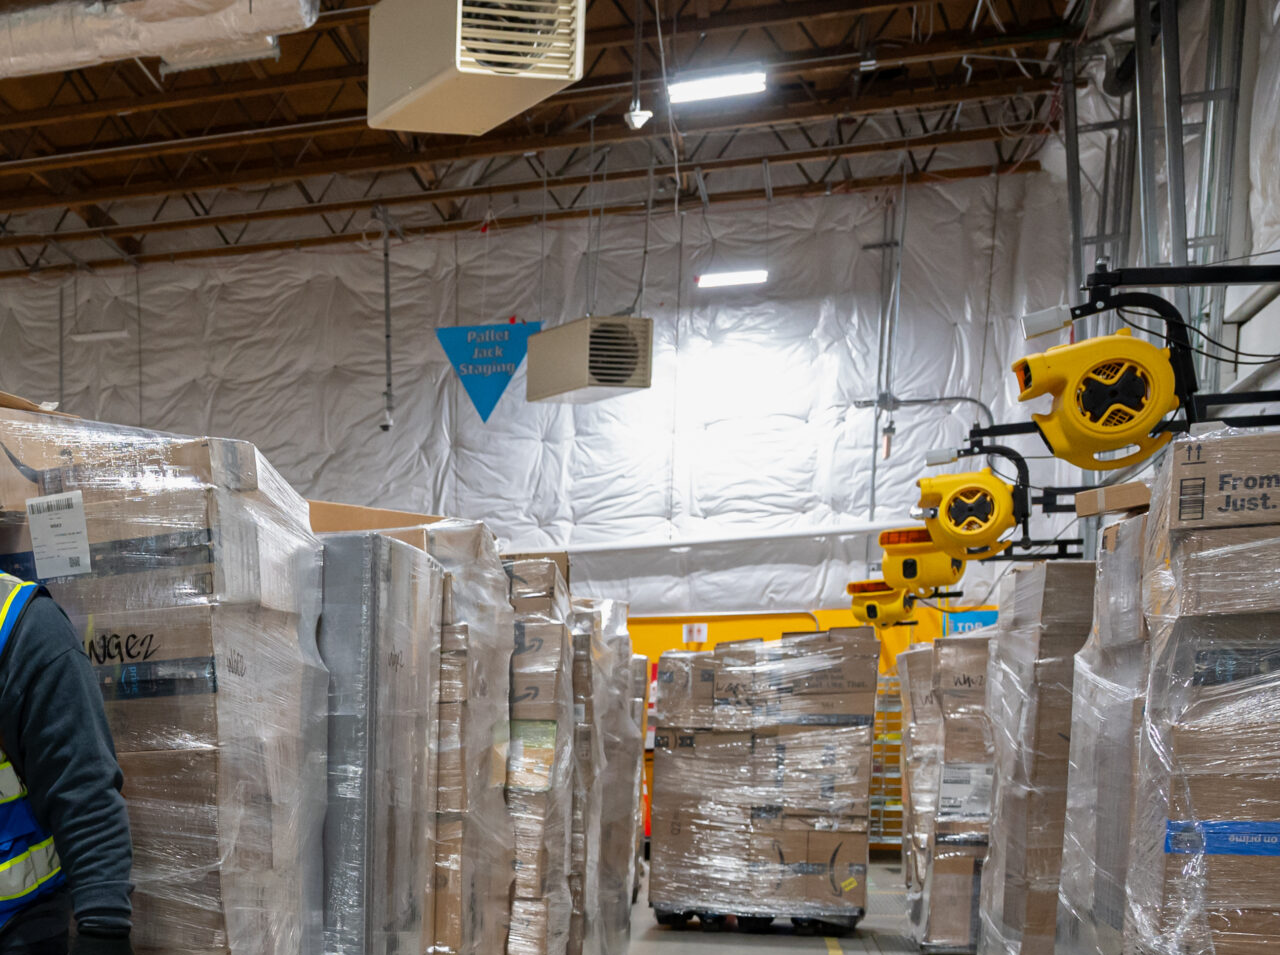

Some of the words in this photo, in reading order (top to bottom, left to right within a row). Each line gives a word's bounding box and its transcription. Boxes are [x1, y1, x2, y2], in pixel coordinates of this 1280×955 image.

[467, 329, 510, 343] Pallet
[471, 345, 504, 359] Jack
[458, 362, 516, 377] Staging
[1218, 473, 1280, 491] From
[1217, 493, 1278, 512] Just.
[127, 666, 139, 694] prime
[1228, 833, 1262, 845] prime
